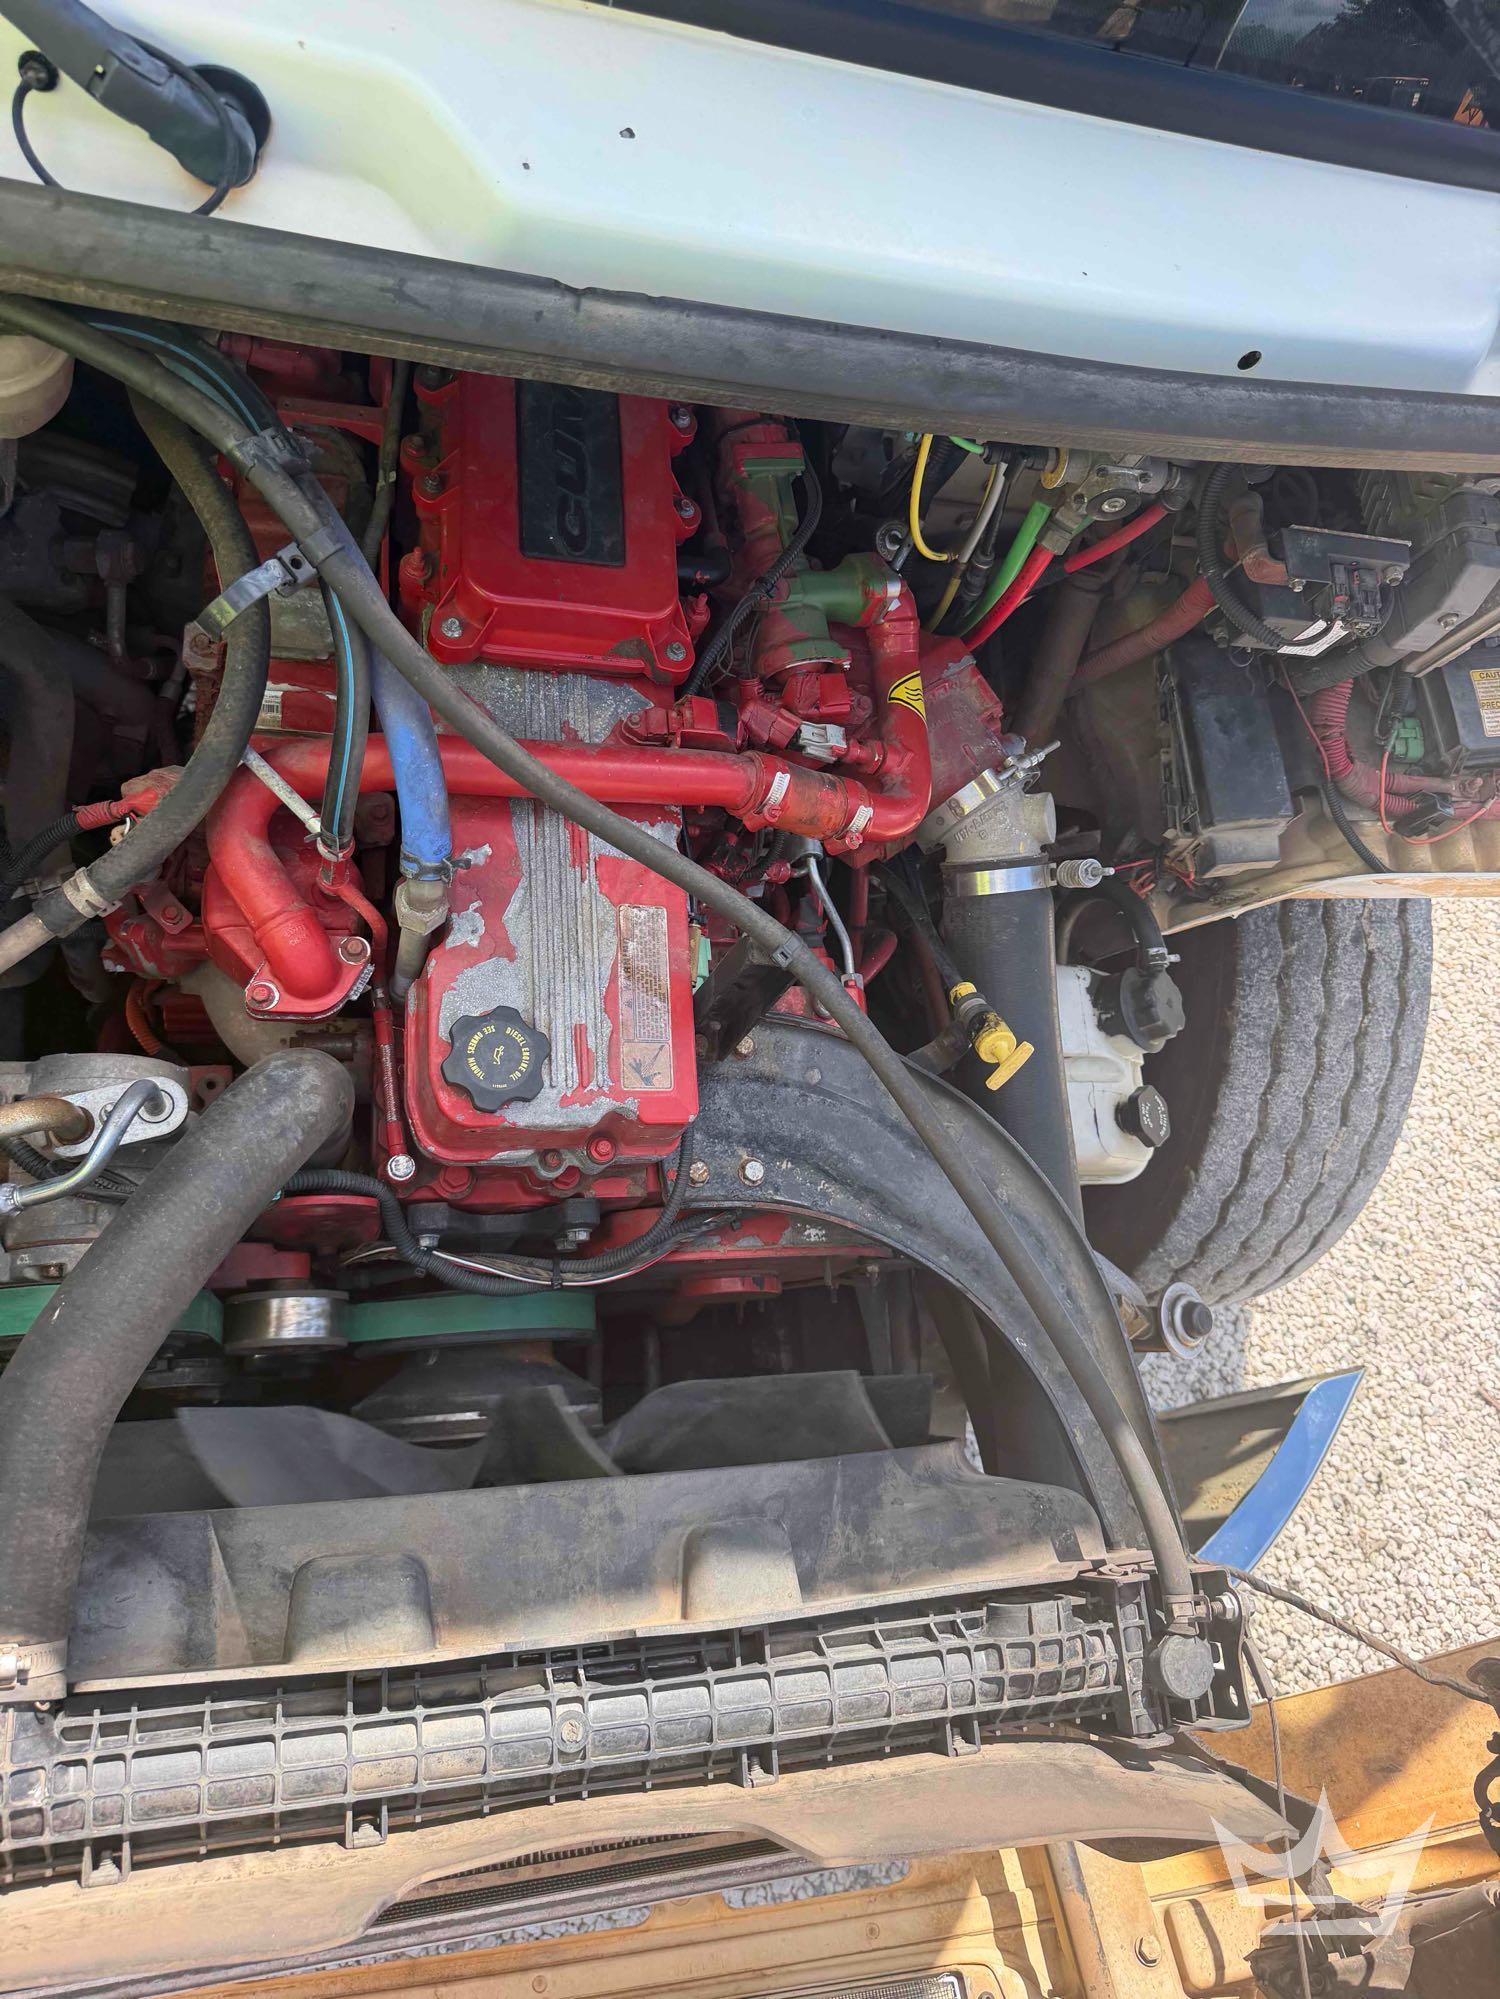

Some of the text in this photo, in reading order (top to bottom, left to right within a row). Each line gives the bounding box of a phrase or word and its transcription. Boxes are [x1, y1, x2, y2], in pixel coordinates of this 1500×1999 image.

[467, 1025, 495, 1079] SEE OWNERS MANUAL
[506, 1027, 530, 1080] DIESEL ENGINE OIL
